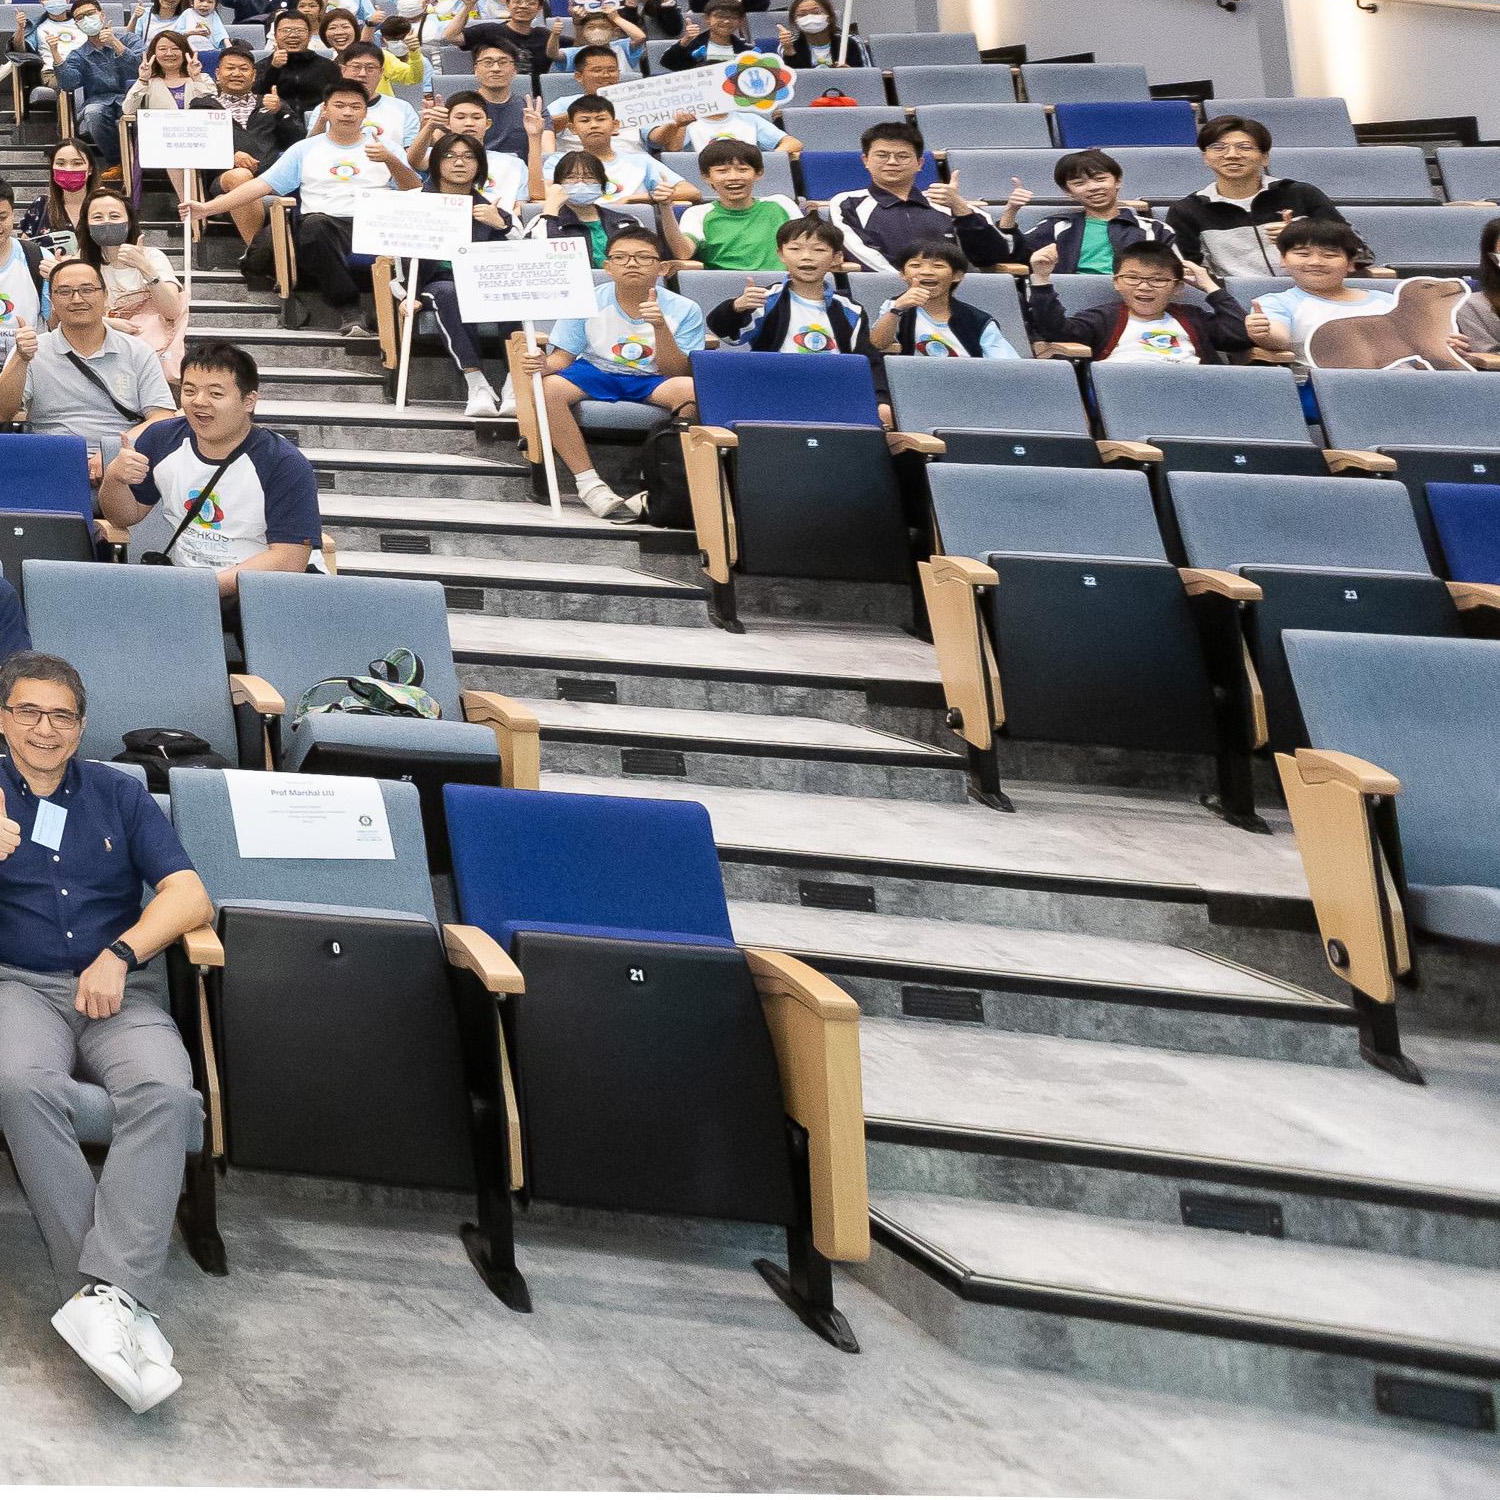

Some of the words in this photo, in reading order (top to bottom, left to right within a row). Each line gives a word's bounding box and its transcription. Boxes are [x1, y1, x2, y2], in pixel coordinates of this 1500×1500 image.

[625, 90, 704, 114] ROBOTICS
[207, 112, 227, 120] T05
[441, 196, 465, 207] T02
[552, 240, 577, 252] T01
[473, 263, 514, 274] SACRED
[517, 262, 553, 271] HEART
[555, 261, 568, 269] OF
[479, 271, 508, 281] MARY
[509, 269, 565, 279] CATHOLIC
[478, 279, 524, 289] PRIMARY
[526, 276, 571, 287] SCHOOL
[1084, 576, 1097, 586] 22
[1345, 589, 1358, 600] 23
[270, 788, 292, 797] Prof
[293, 788, 321, 797] Marshal
[630, 968, 645, 982] 21
